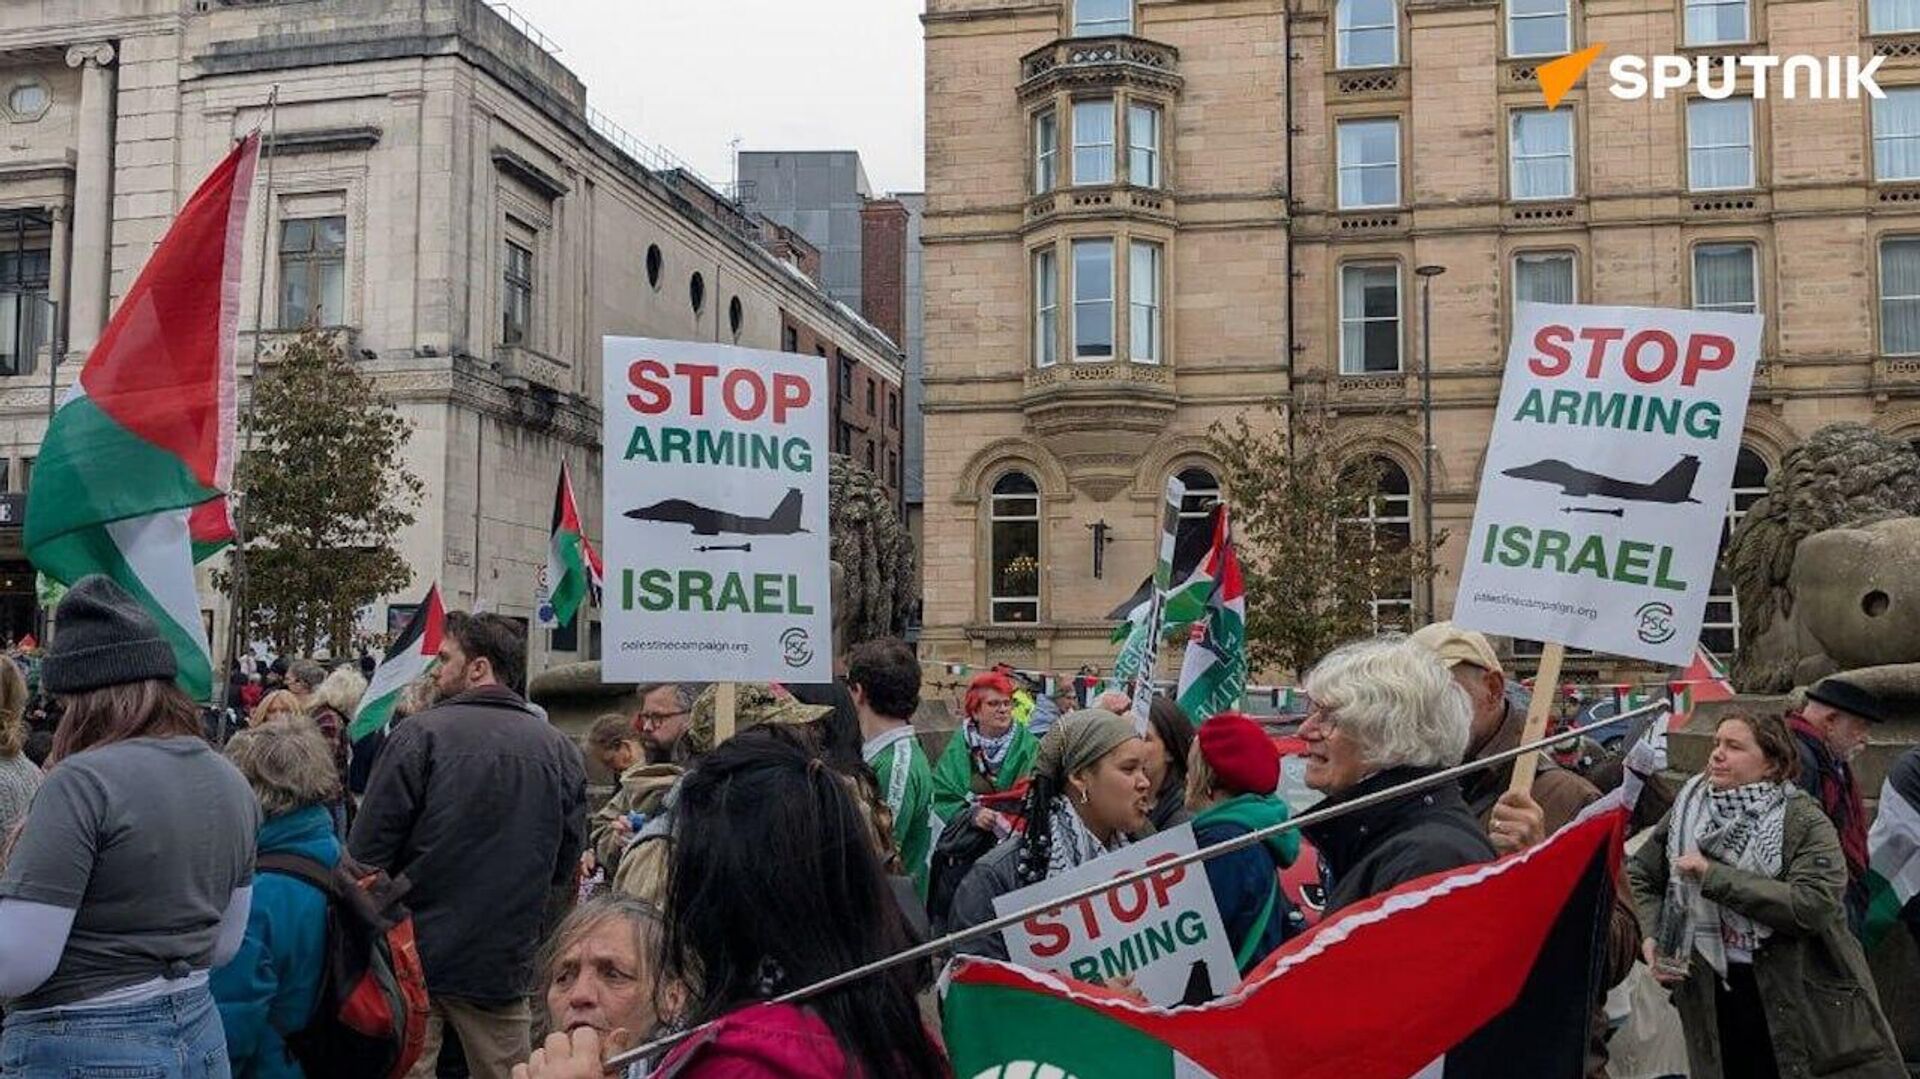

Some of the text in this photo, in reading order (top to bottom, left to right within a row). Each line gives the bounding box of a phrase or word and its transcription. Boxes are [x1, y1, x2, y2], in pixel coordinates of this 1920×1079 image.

[1528, 325, 1736, 387] STOP
[627, 360, 811, 424] STOP
[1513, 388, 1722, 440] ARMING
[623, 426, 812, 473] ARMING
[1482, 524, 1688, 591] ISRAEL
[622, 569, 814, 615] ISRAEL
[621, 638, 749, 653] palestinecampaign.org
[1641, 614, 1670, 631] PSC
[1024, 852, 1187, 958] STOP
[1069, 910, 1208, 986] RMING
